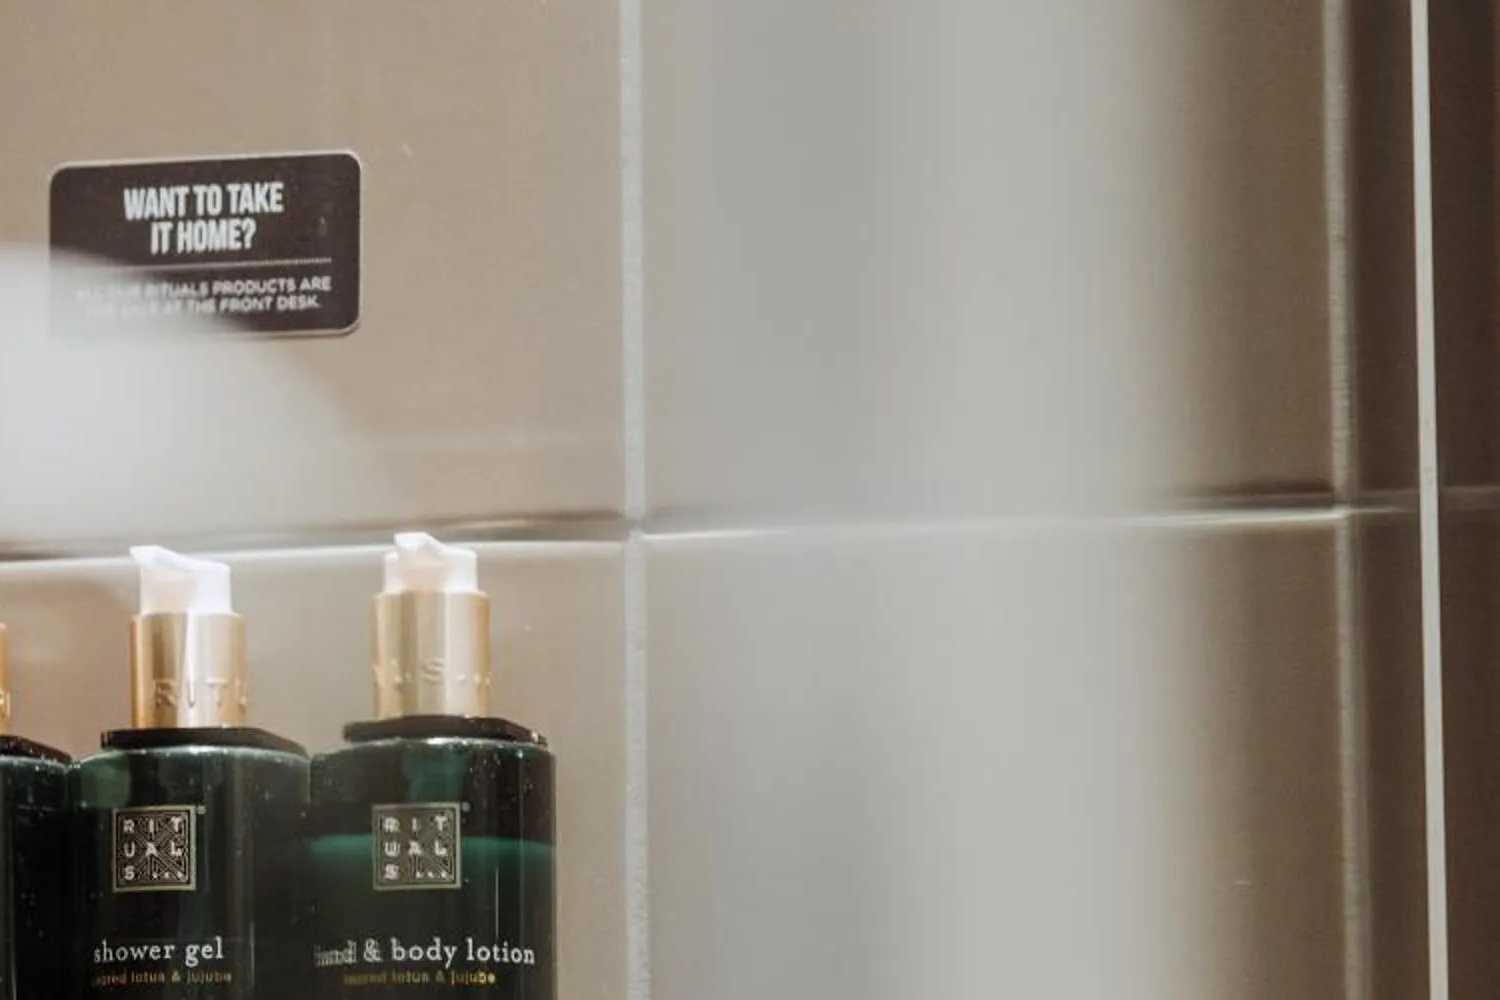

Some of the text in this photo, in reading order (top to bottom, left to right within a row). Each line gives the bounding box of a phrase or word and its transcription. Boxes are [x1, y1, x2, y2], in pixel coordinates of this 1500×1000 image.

[123, 181, 285, 221] WANT TO TAKE
[150, 217, 257, 255] IT HOME?
[211, 277, 297, 297] PRODUCTS
[299, 275, 332, 292] ARE
[219, 296, 275, 314] FRONT
[93, 935, 225, 968] shower gel
[363, 937, 384, 963] &
[389, 936, 459, 969] body
[465, 936, 537, 966] lotion
